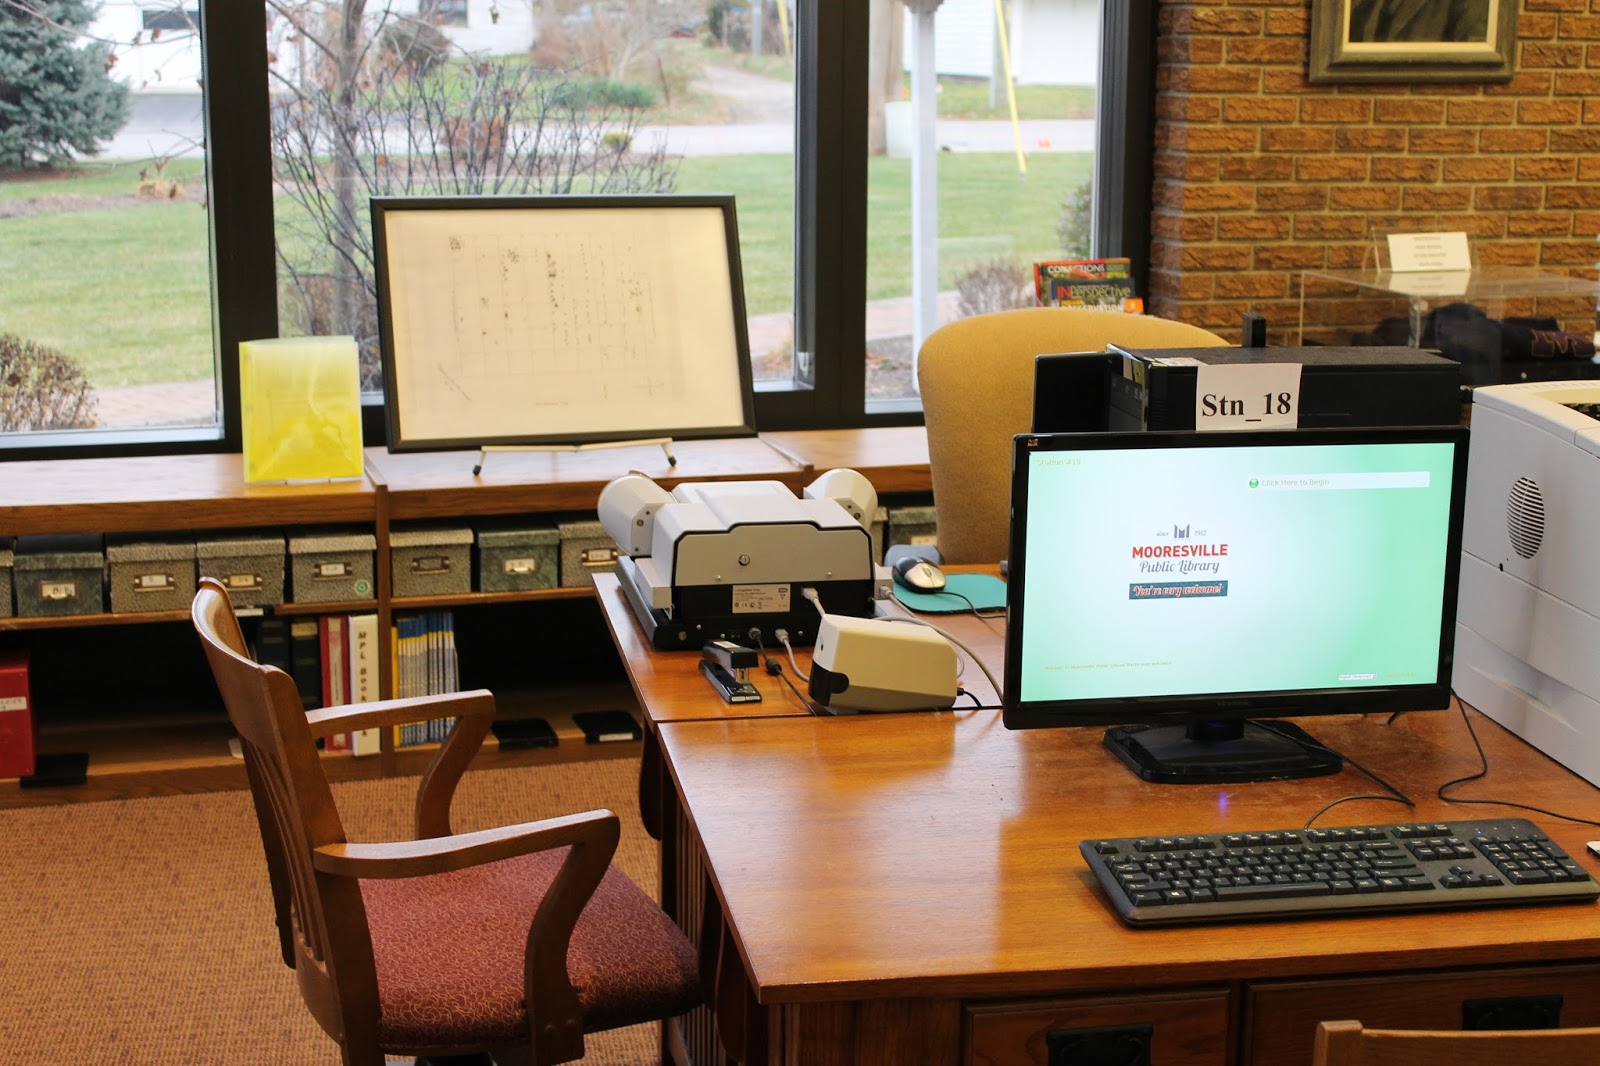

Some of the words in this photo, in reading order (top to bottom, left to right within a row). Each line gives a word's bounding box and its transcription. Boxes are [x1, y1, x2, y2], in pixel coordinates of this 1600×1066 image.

[1202, 392, 1291, 422] Stn_18
[1261, 479, 1279, 487] Click
[1310, 479, 1330, 487] Begin
[1132, 544, 1228, 559] MOORESVILLE
[1140, 560, 1175, 573] Public
[1178, 559, 1220, 575] Library
[1133, 585, 1162, 597] You're
[1162, 585, 1182, 598] very
[1183, 583, 1223, 596] welcome!
